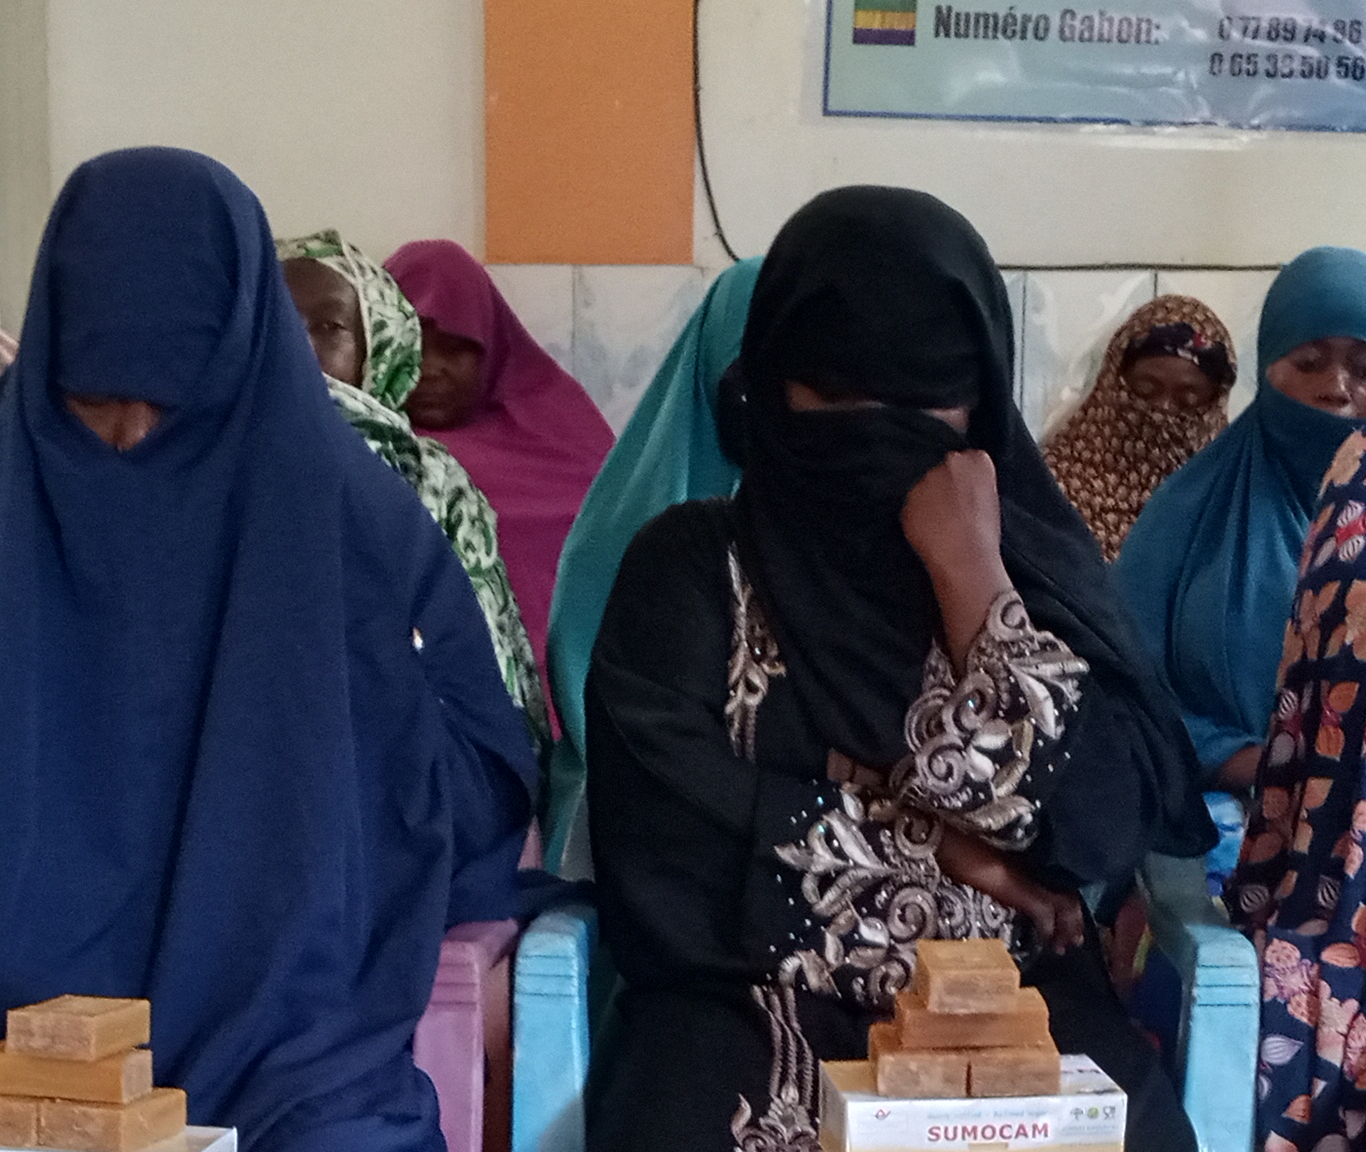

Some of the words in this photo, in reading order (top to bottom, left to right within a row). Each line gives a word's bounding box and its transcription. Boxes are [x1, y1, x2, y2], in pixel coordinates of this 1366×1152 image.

[934, 5, 1050, 41] Numéro
[1059, 8, 1160, 44] Gabon:
[1336, 55, 1366, 81] 56
[927, 1123, 1049, 1142] SUMOCAM
